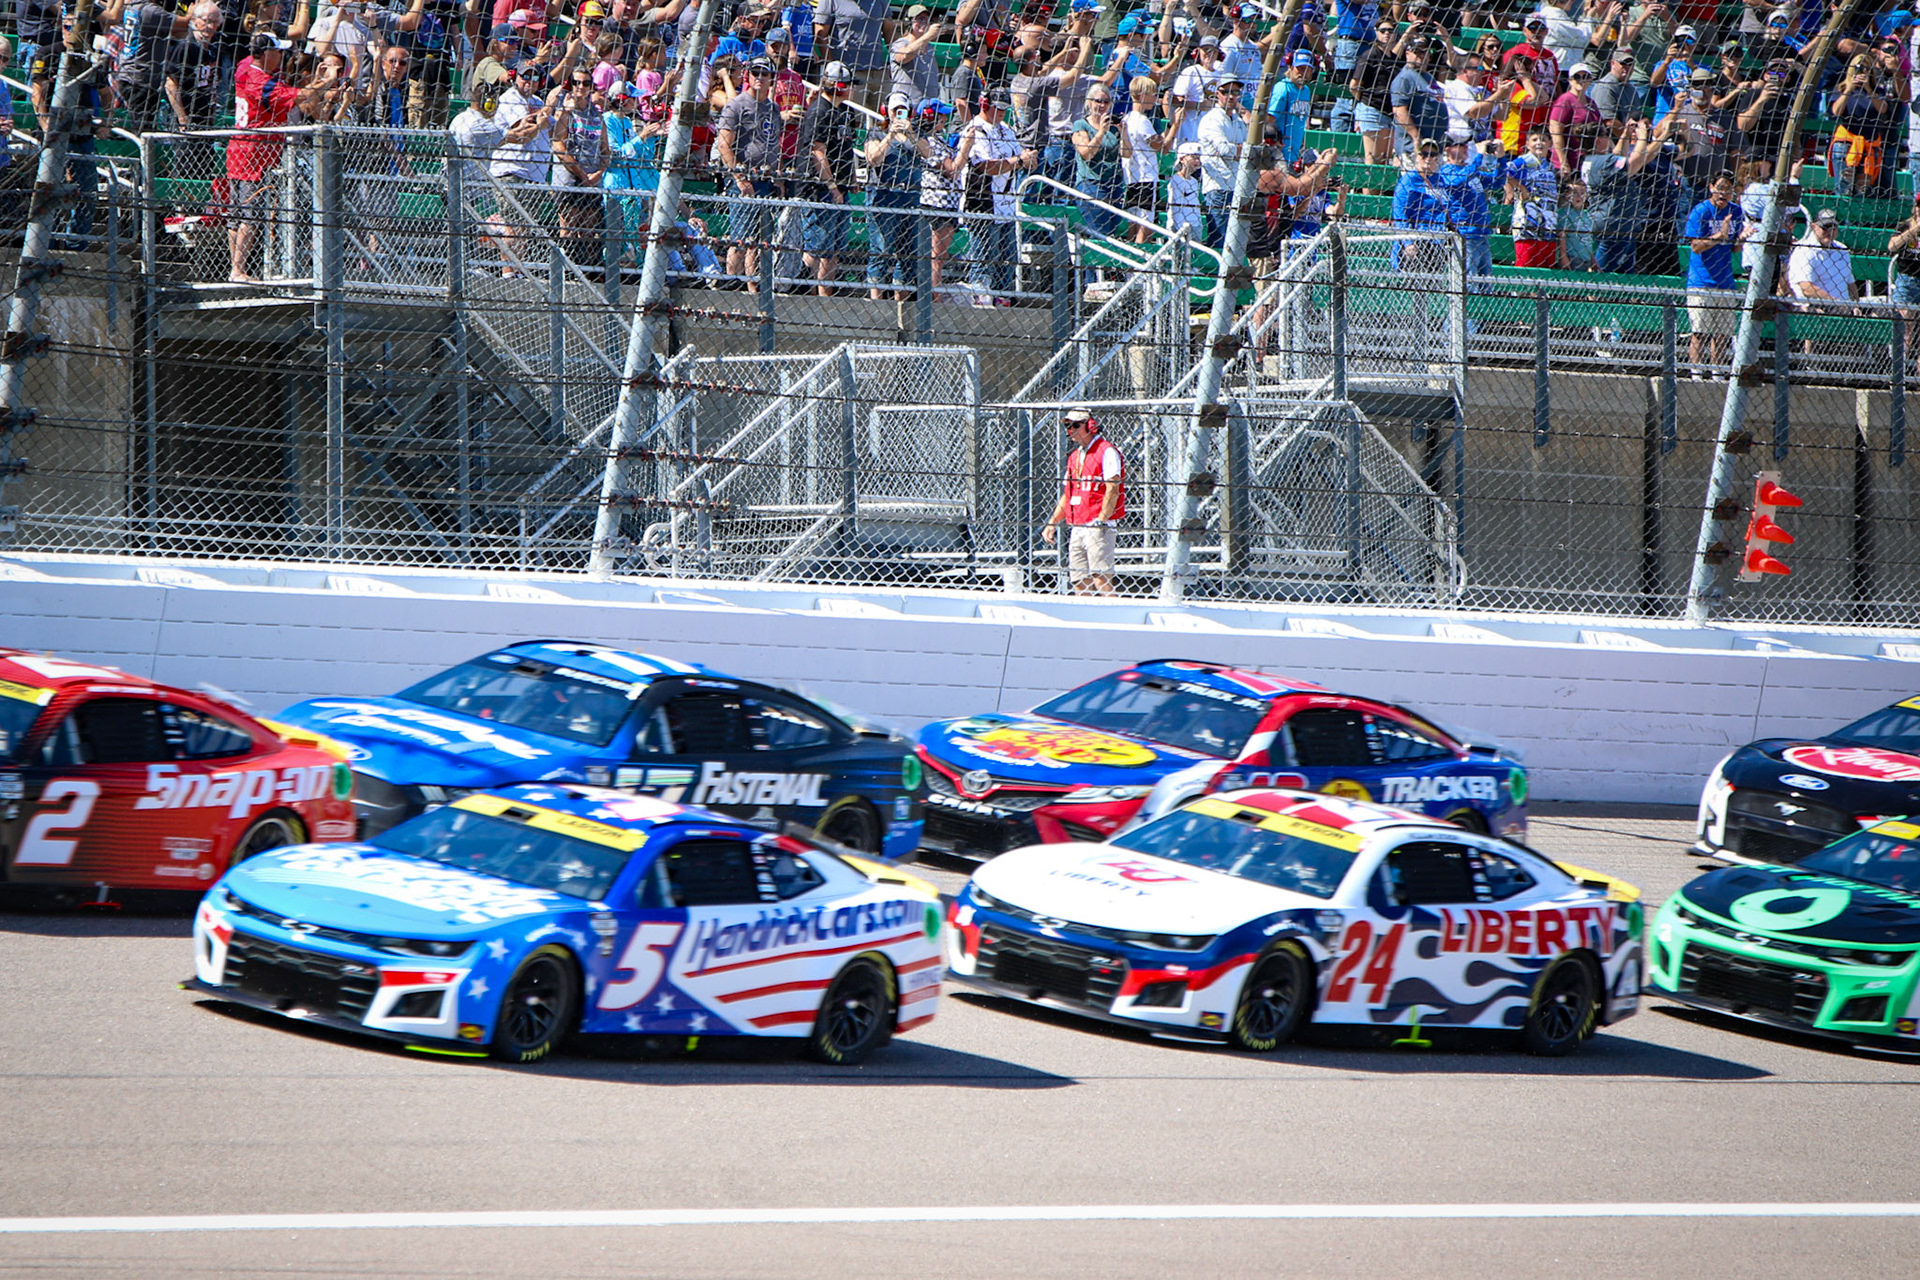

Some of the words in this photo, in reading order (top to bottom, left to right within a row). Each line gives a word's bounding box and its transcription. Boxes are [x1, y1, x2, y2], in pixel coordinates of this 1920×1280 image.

[691, 761, 829, 806] FASTENAL
[1381, 775, 1499, 803] TRACKER
[14, 776, 102, 868] 2
[1324, 920, 1408, 1004] 24
[1439, 906, 1617, 954] LIBERTY
[597, 921, 685, 1012] 5
